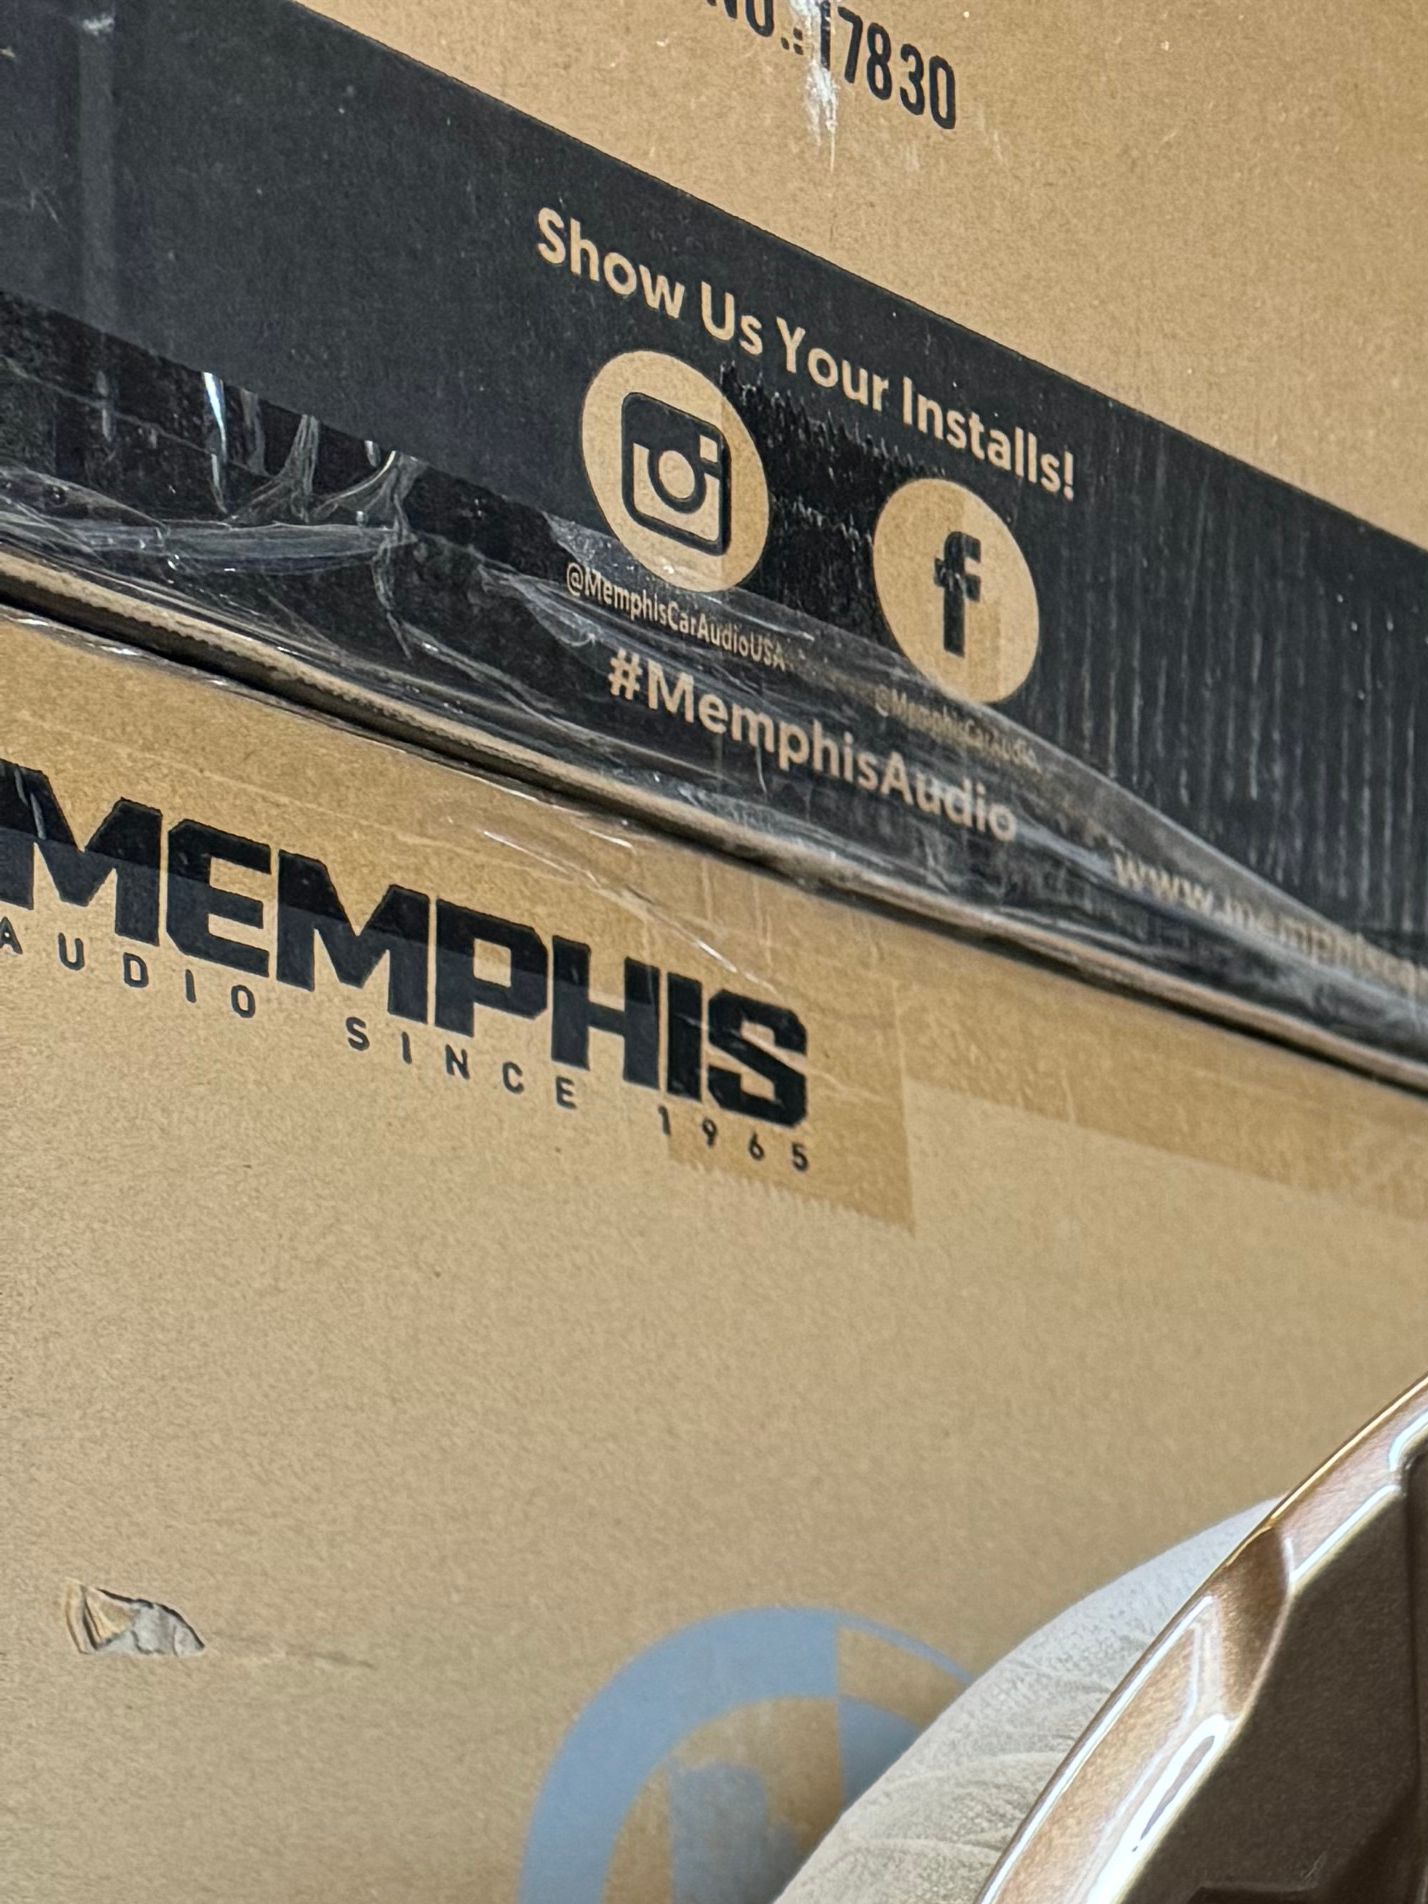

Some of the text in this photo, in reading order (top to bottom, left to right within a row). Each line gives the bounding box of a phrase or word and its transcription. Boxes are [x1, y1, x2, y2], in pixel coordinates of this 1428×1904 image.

[536, 206, 1077, 502] Show Us Your Installs!
[566, 561, 787, 672] @MemphisCarAudioUSA
[608, 647, 1019, 843] #MemphisAudio
[0, 757, 809, 1129] MEMPHIS
[0, 916, 811, 1173] AUDIO SINCE 1965
